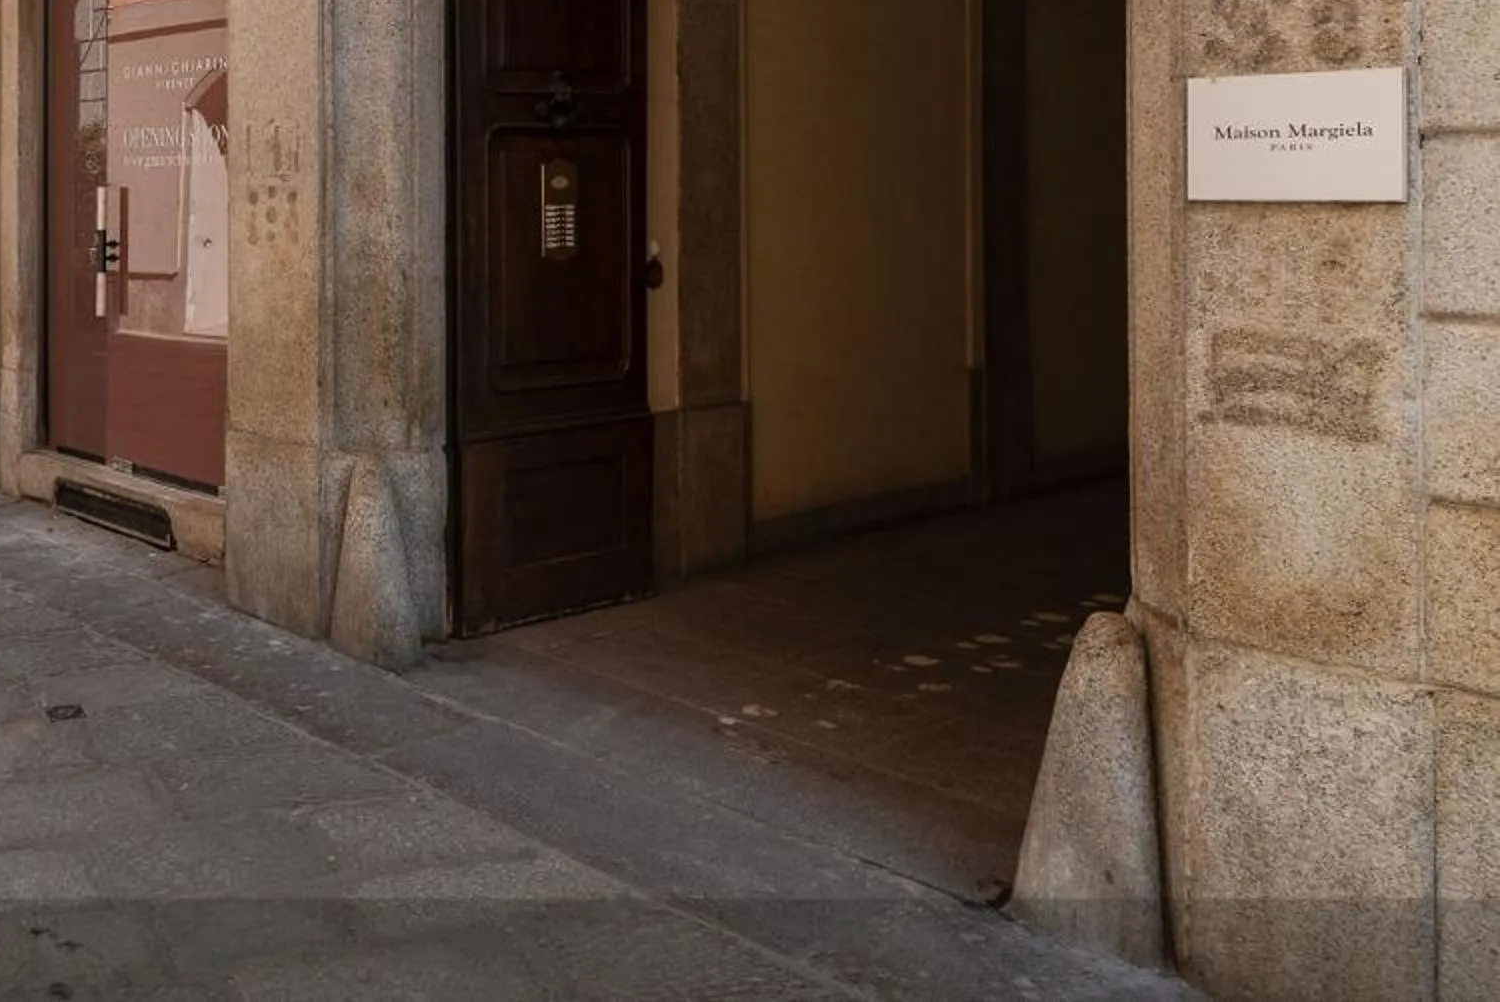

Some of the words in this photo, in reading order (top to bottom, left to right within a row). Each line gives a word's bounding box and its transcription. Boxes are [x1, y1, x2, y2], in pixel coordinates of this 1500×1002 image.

[1213, 125, 1281, 141] Maison
[1287, 121, 1373, 140] Margiela
[1270, 143, 1313, 151] PARIS
